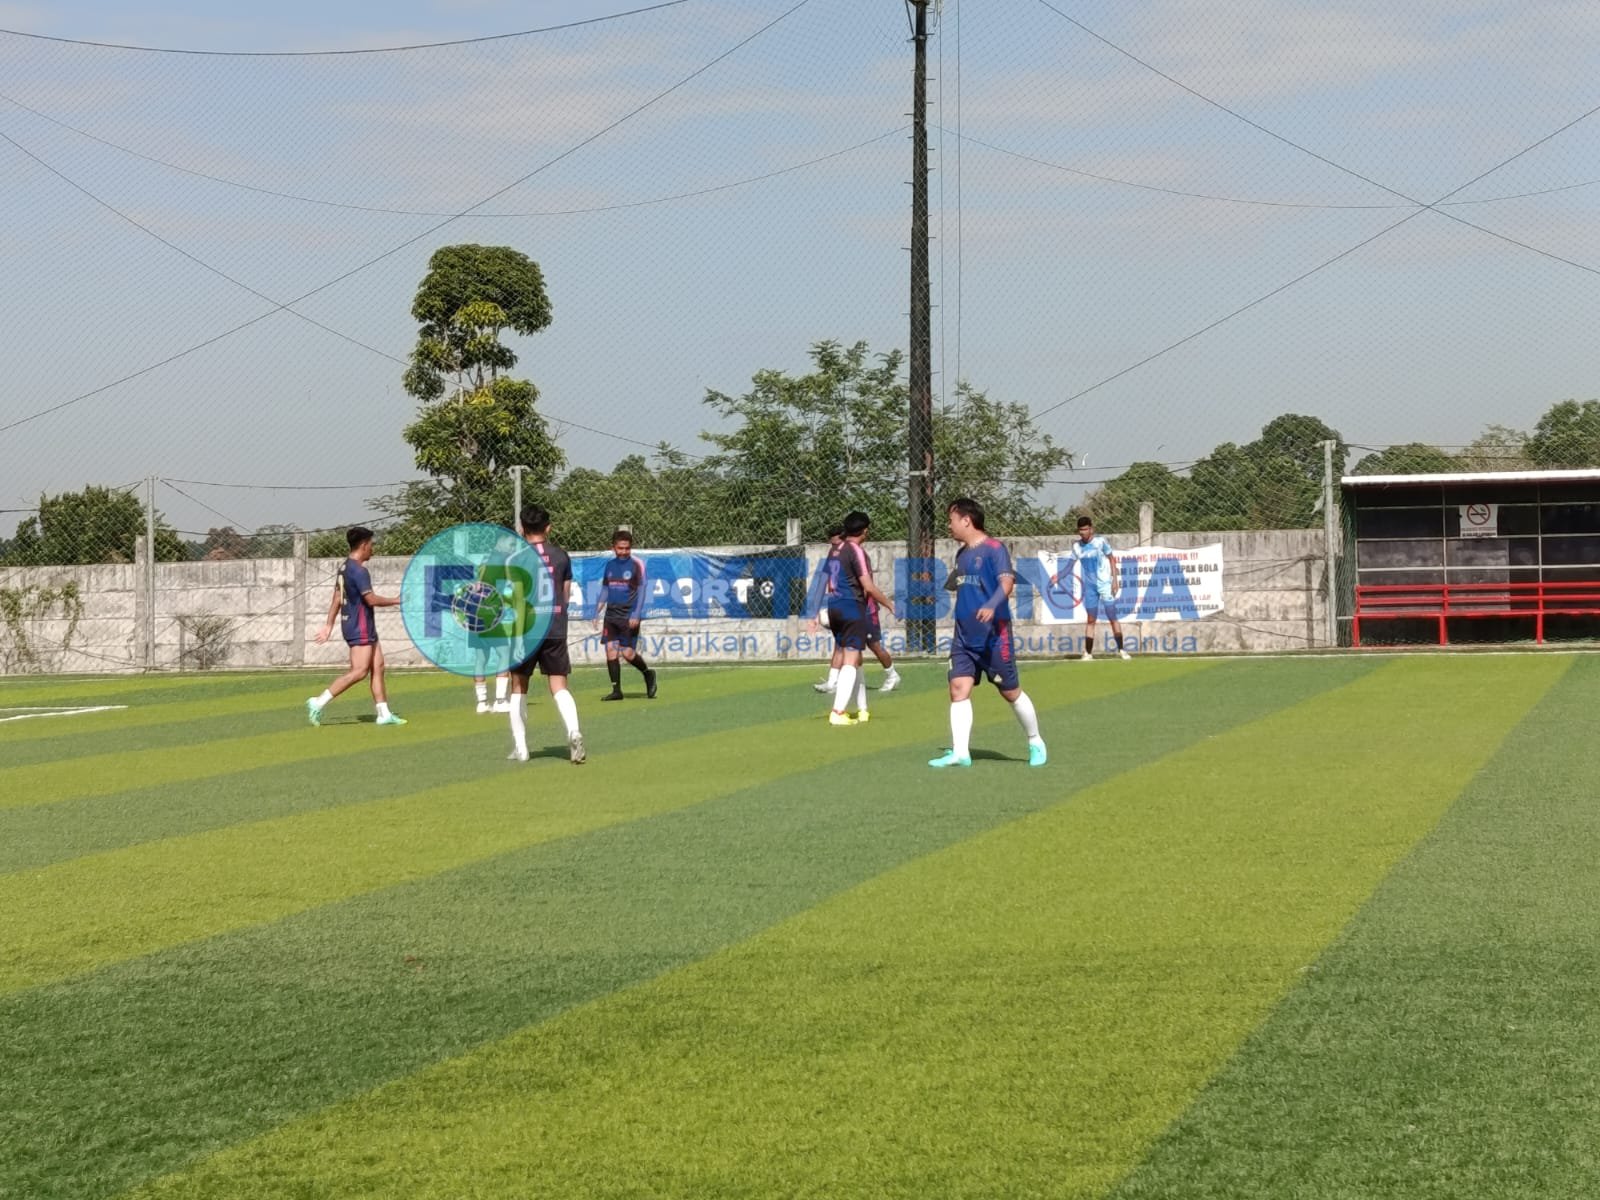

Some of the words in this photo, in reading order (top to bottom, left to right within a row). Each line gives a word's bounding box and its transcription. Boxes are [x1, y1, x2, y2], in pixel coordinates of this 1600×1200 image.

[1128, 565, 1170, 575] LAPANGAN
[1171, 564, 1197, 574] SEPAK
[1198, 563, 1219, 572] BOLA
